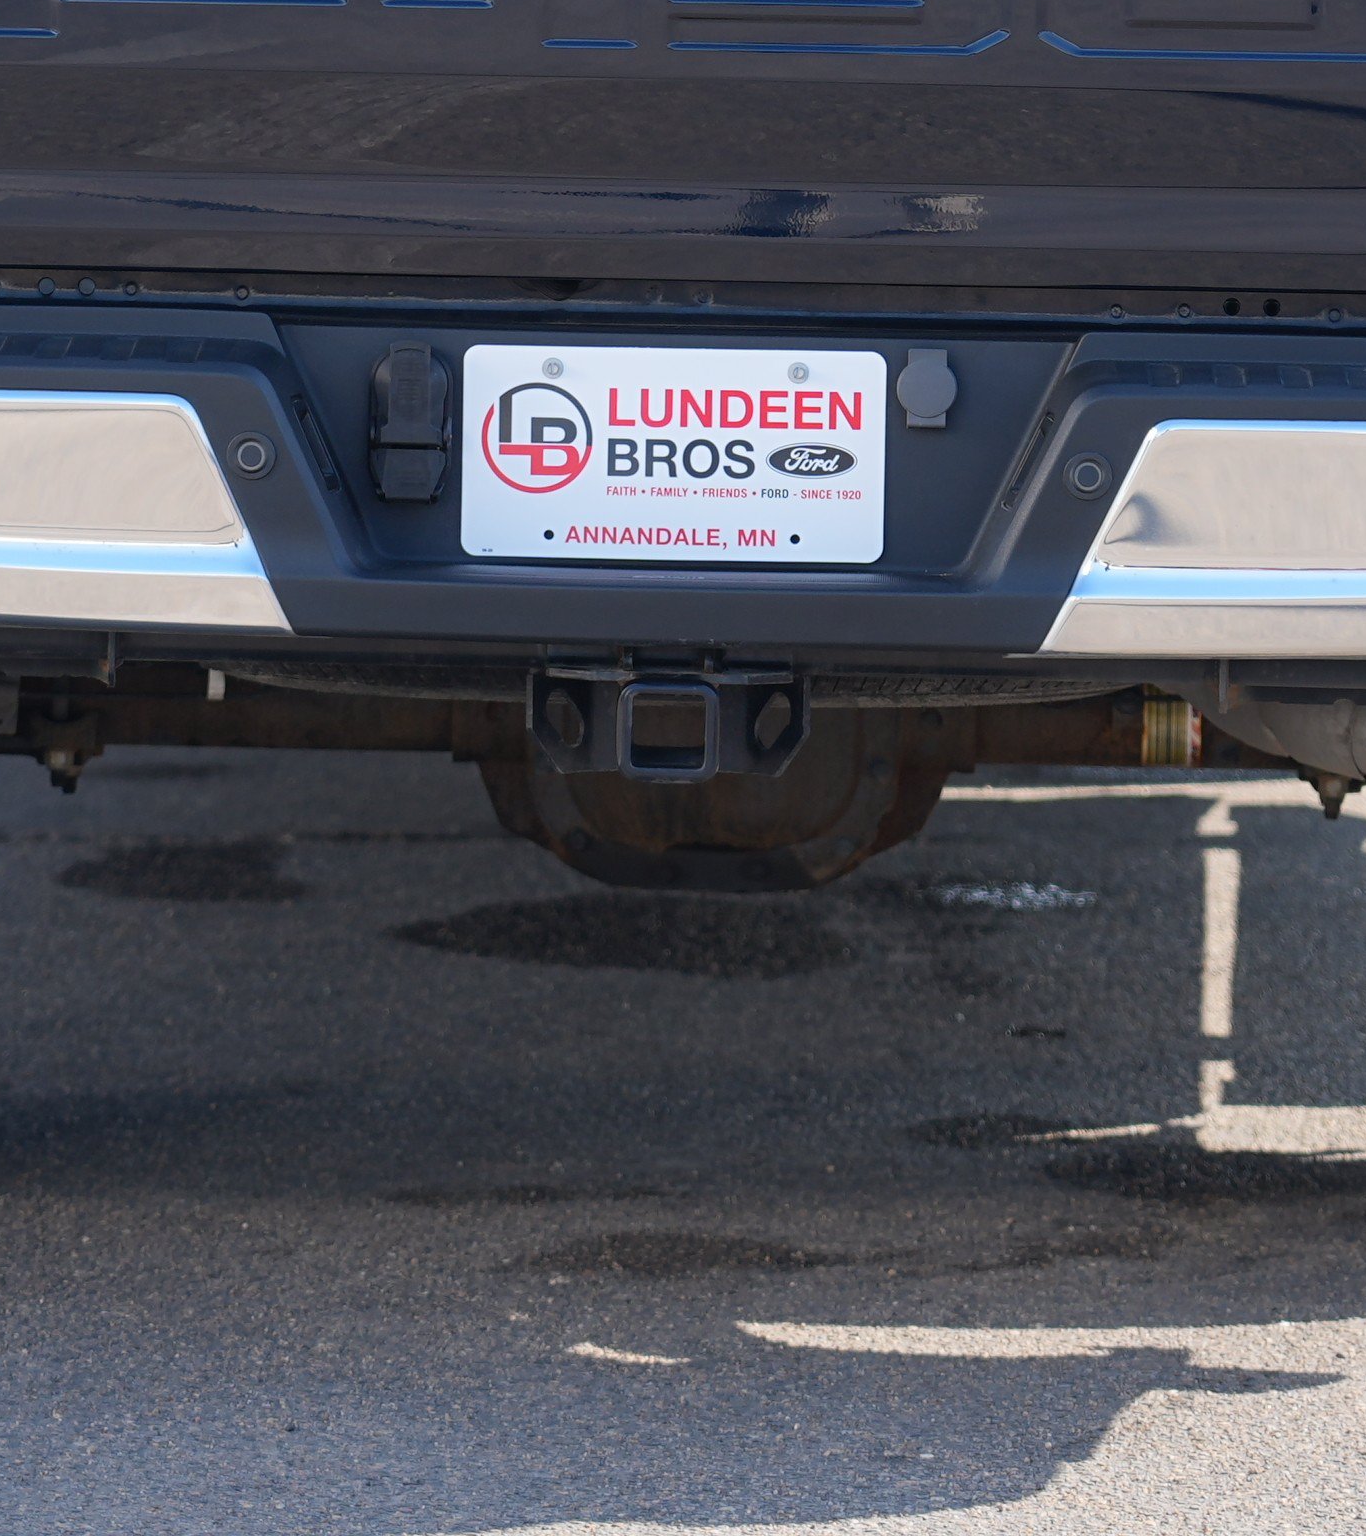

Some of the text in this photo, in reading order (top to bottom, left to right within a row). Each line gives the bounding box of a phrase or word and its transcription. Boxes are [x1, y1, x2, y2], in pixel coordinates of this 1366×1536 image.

[607, 387, 863, 431] LUNDEEN
[606, 437, 841, 480] BROS Ford
[606, 485, 862, 501] FAITH FAMILY FRIENDS FORD SINCE 1920
[564, 524, 777, 550] ANNANDALE, MN
